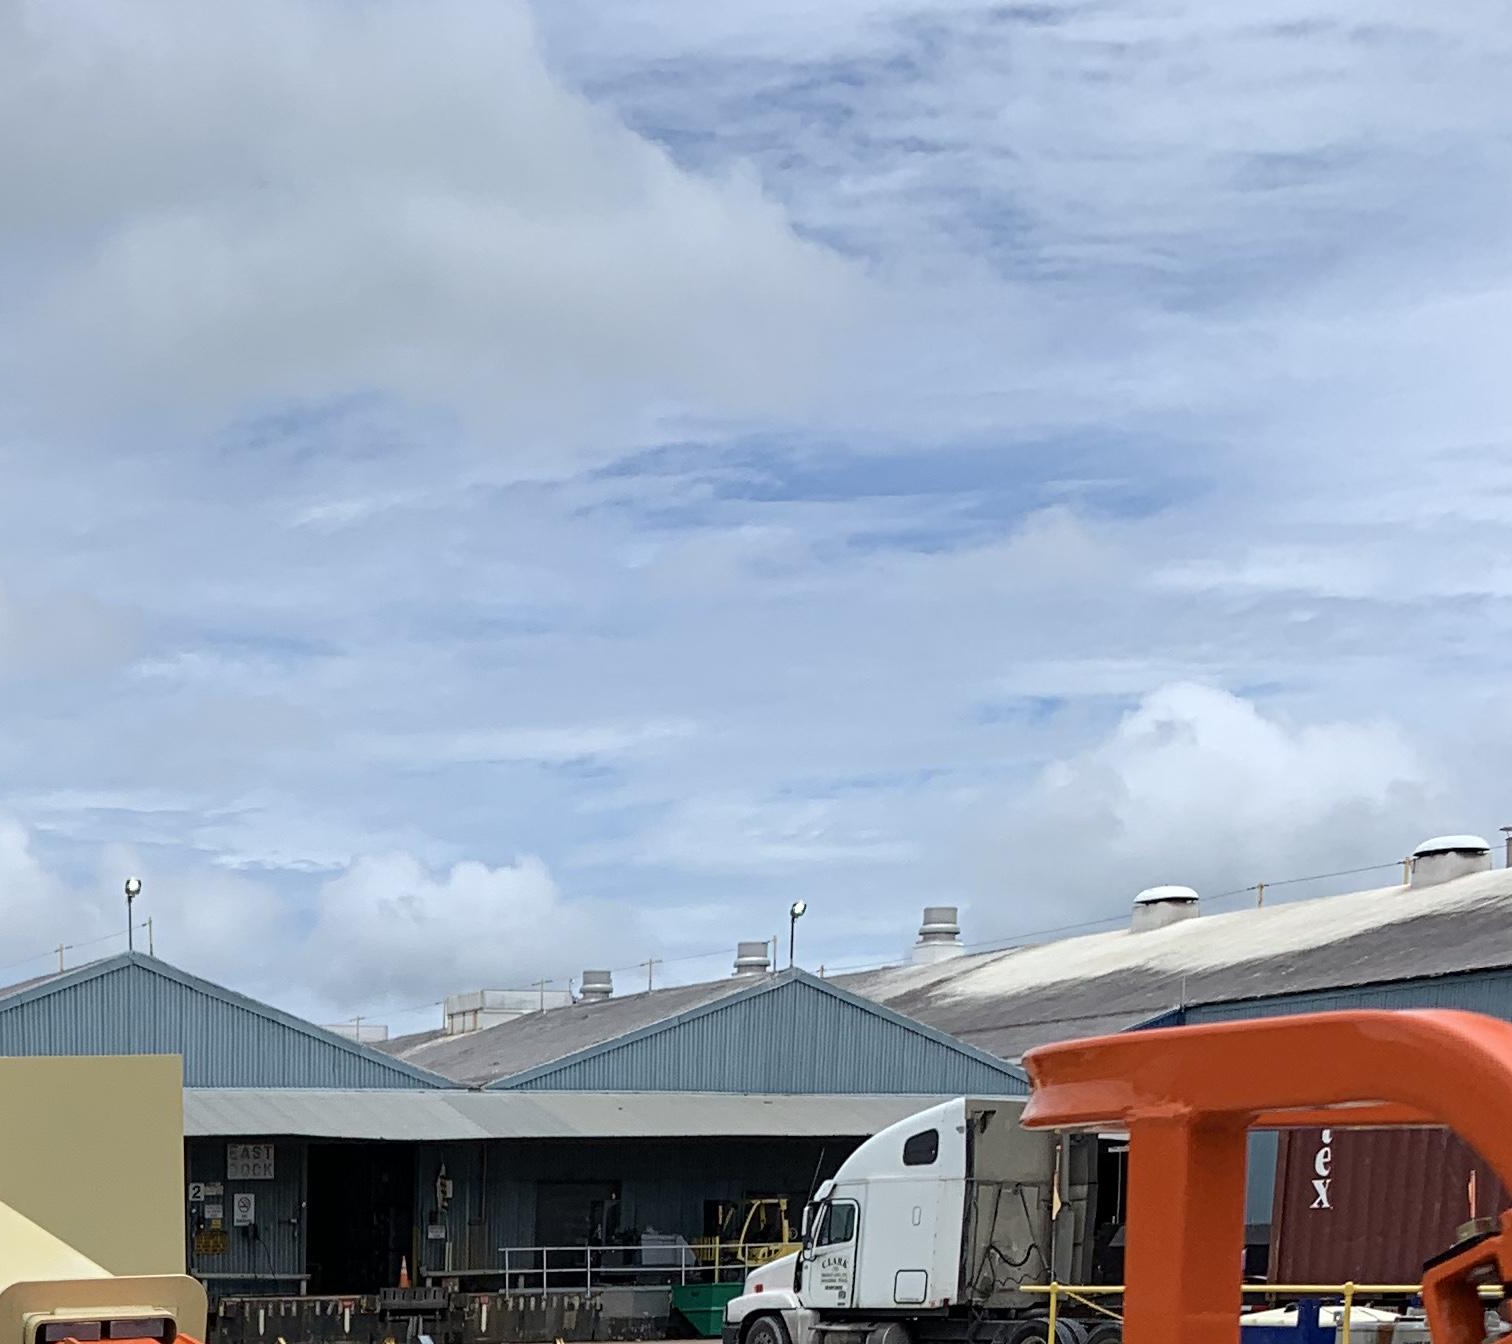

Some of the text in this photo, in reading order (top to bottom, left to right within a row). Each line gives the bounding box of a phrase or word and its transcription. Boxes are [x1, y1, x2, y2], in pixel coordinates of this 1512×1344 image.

[230, 1145, 272, 1160] EAST
[191, 1185, 201, 1199] 2
[821, 1257, 848, 1269] CLARK
